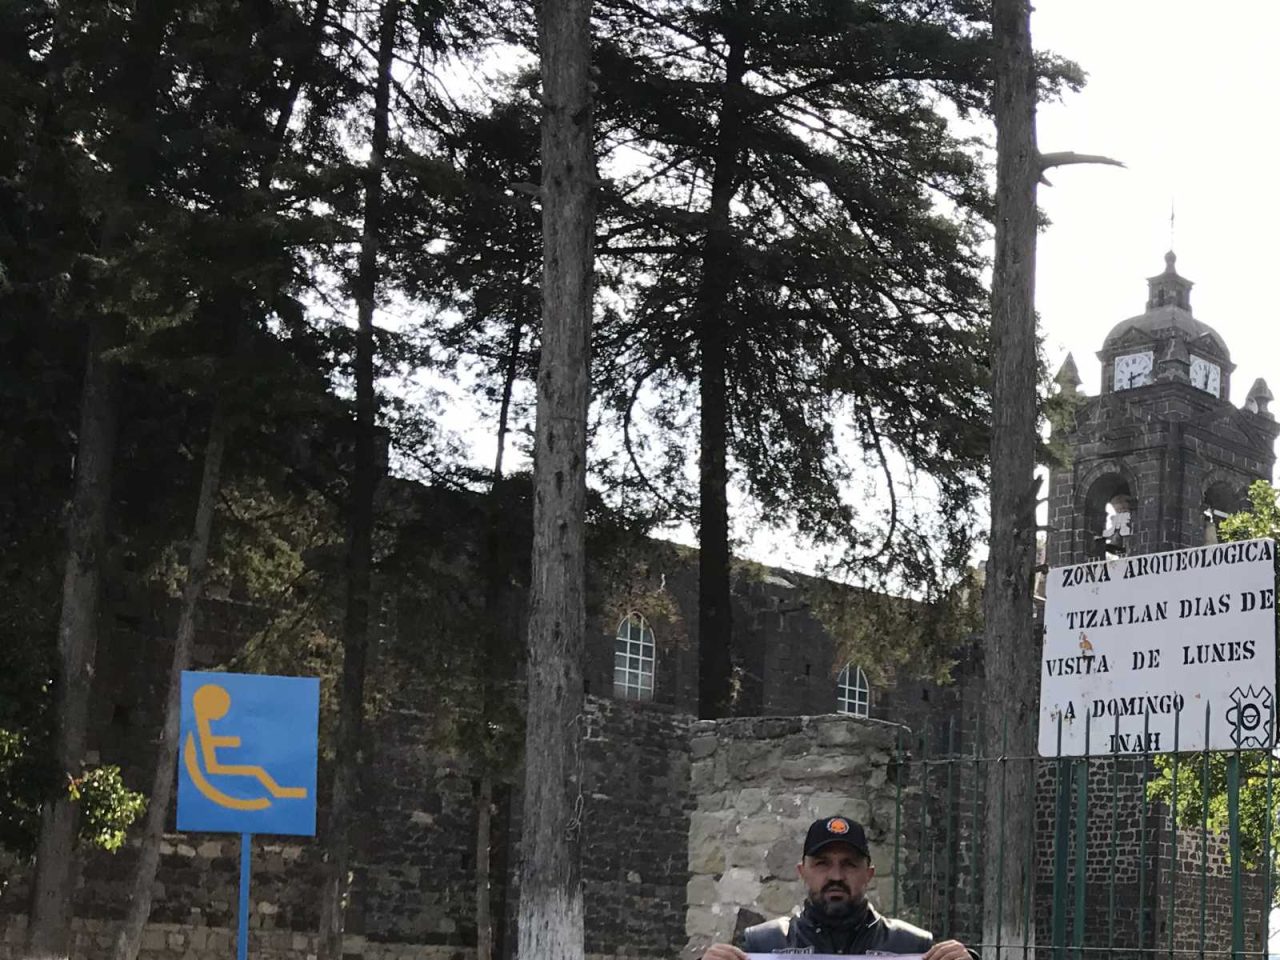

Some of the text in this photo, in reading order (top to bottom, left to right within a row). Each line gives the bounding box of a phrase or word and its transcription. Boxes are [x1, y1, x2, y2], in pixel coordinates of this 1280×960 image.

[1061, 541, 1273, 588] ZONA ARQUEOLOGICA
[1066, 588, 1274, 630] TIZATLAN DIAS DE
[1046, 640, 1256, 677] VISITA DE LUNES
[1064, 693, 1185, 719] A DOMINGO
[1109, 732, 1161, 752] INAH
